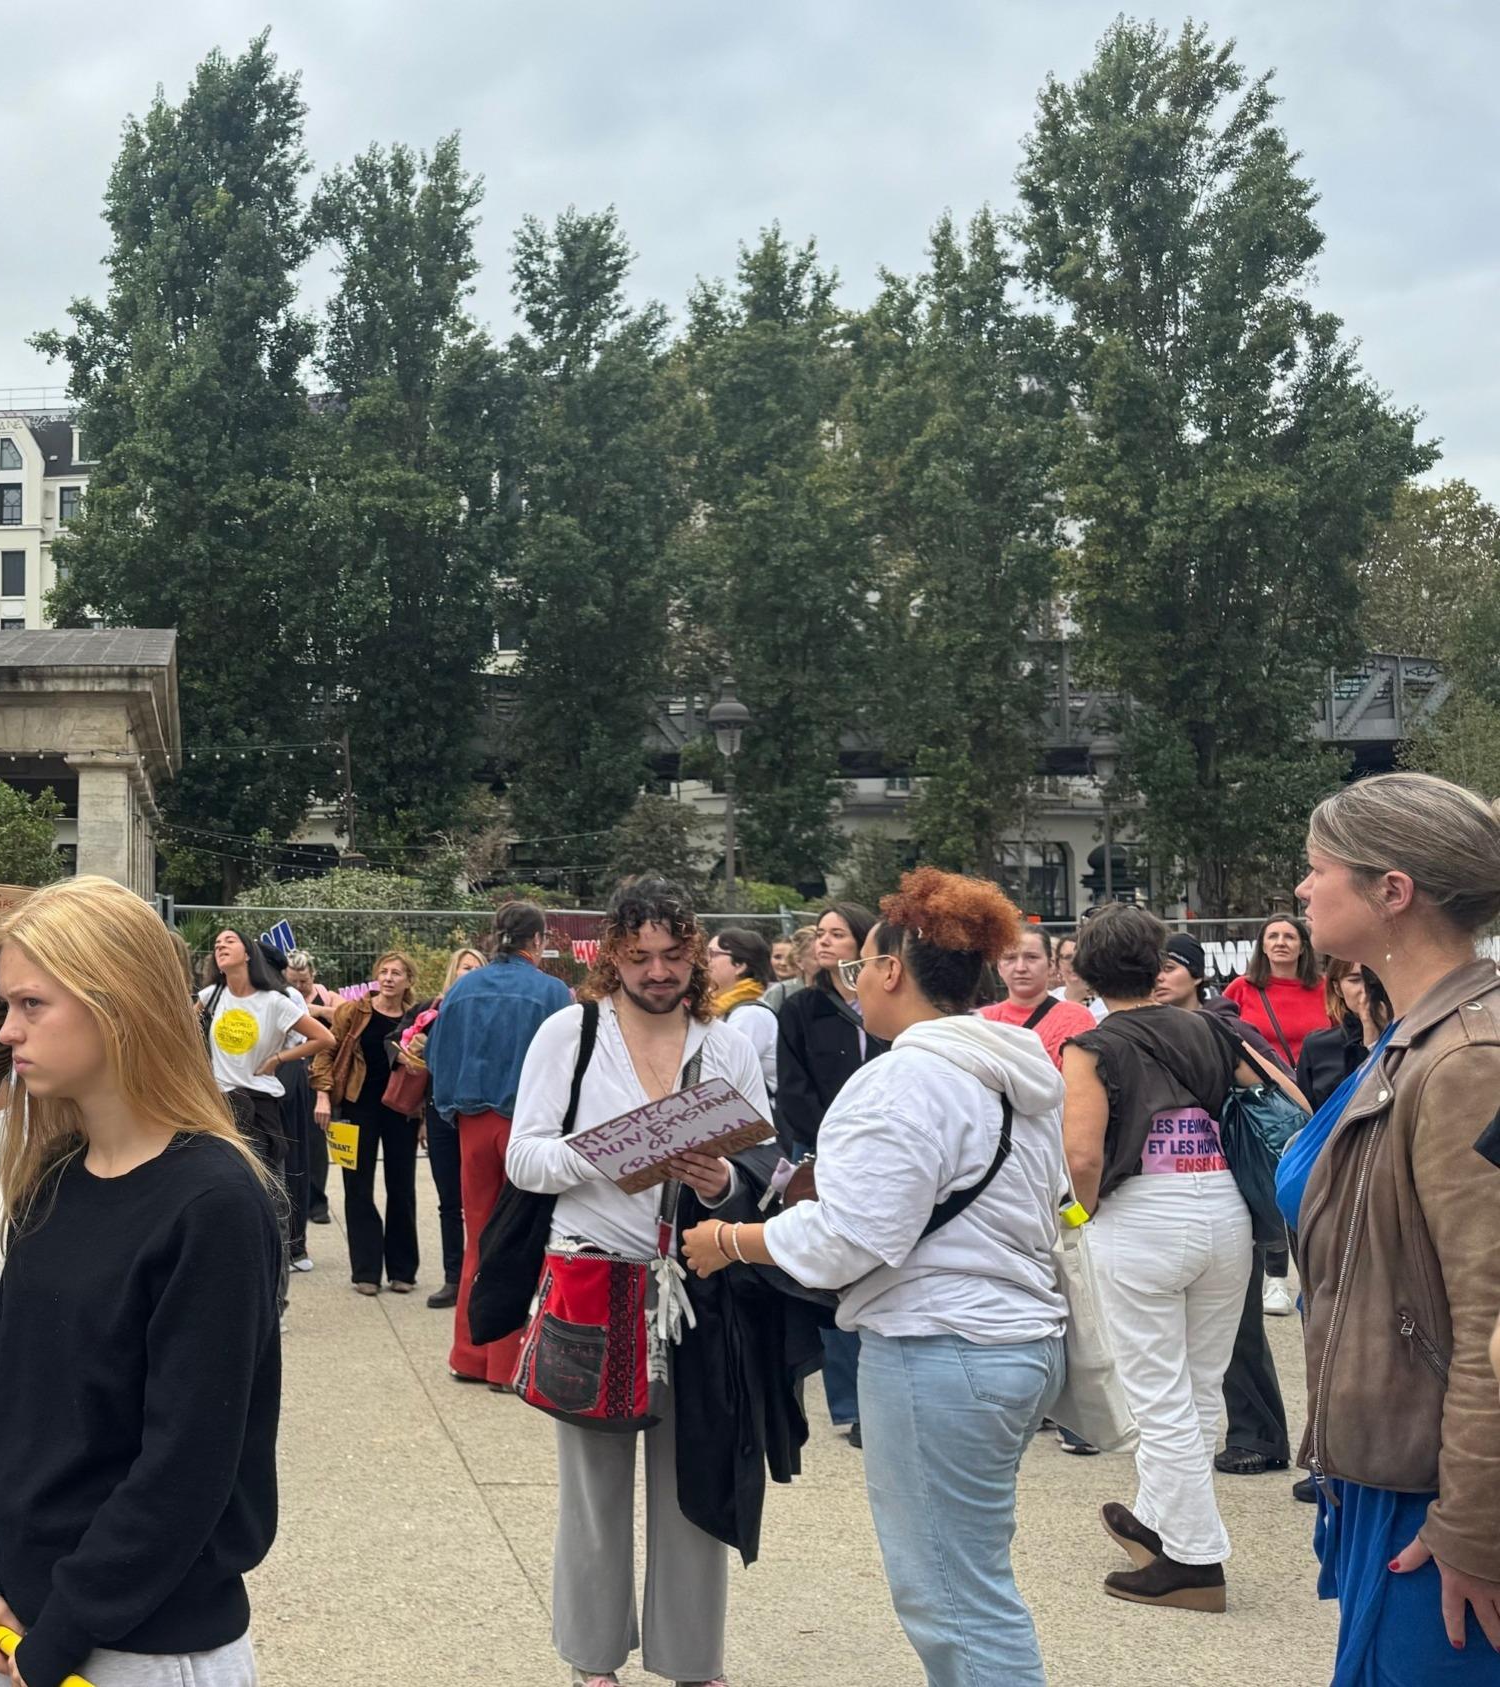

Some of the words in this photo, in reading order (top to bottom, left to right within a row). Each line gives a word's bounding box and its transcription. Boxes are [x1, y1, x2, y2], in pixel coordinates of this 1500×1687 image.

[572, 1086, 714, 1150] RESPECTE
[1150, 1119, 1174, 1134] LES
[585, 1132, 642, 1163] MON
[649, 1134, 673, 1150] OU
[1148, 1140, 1165, 1154] ET
[1170, 1140, 1194, 1155] LES
